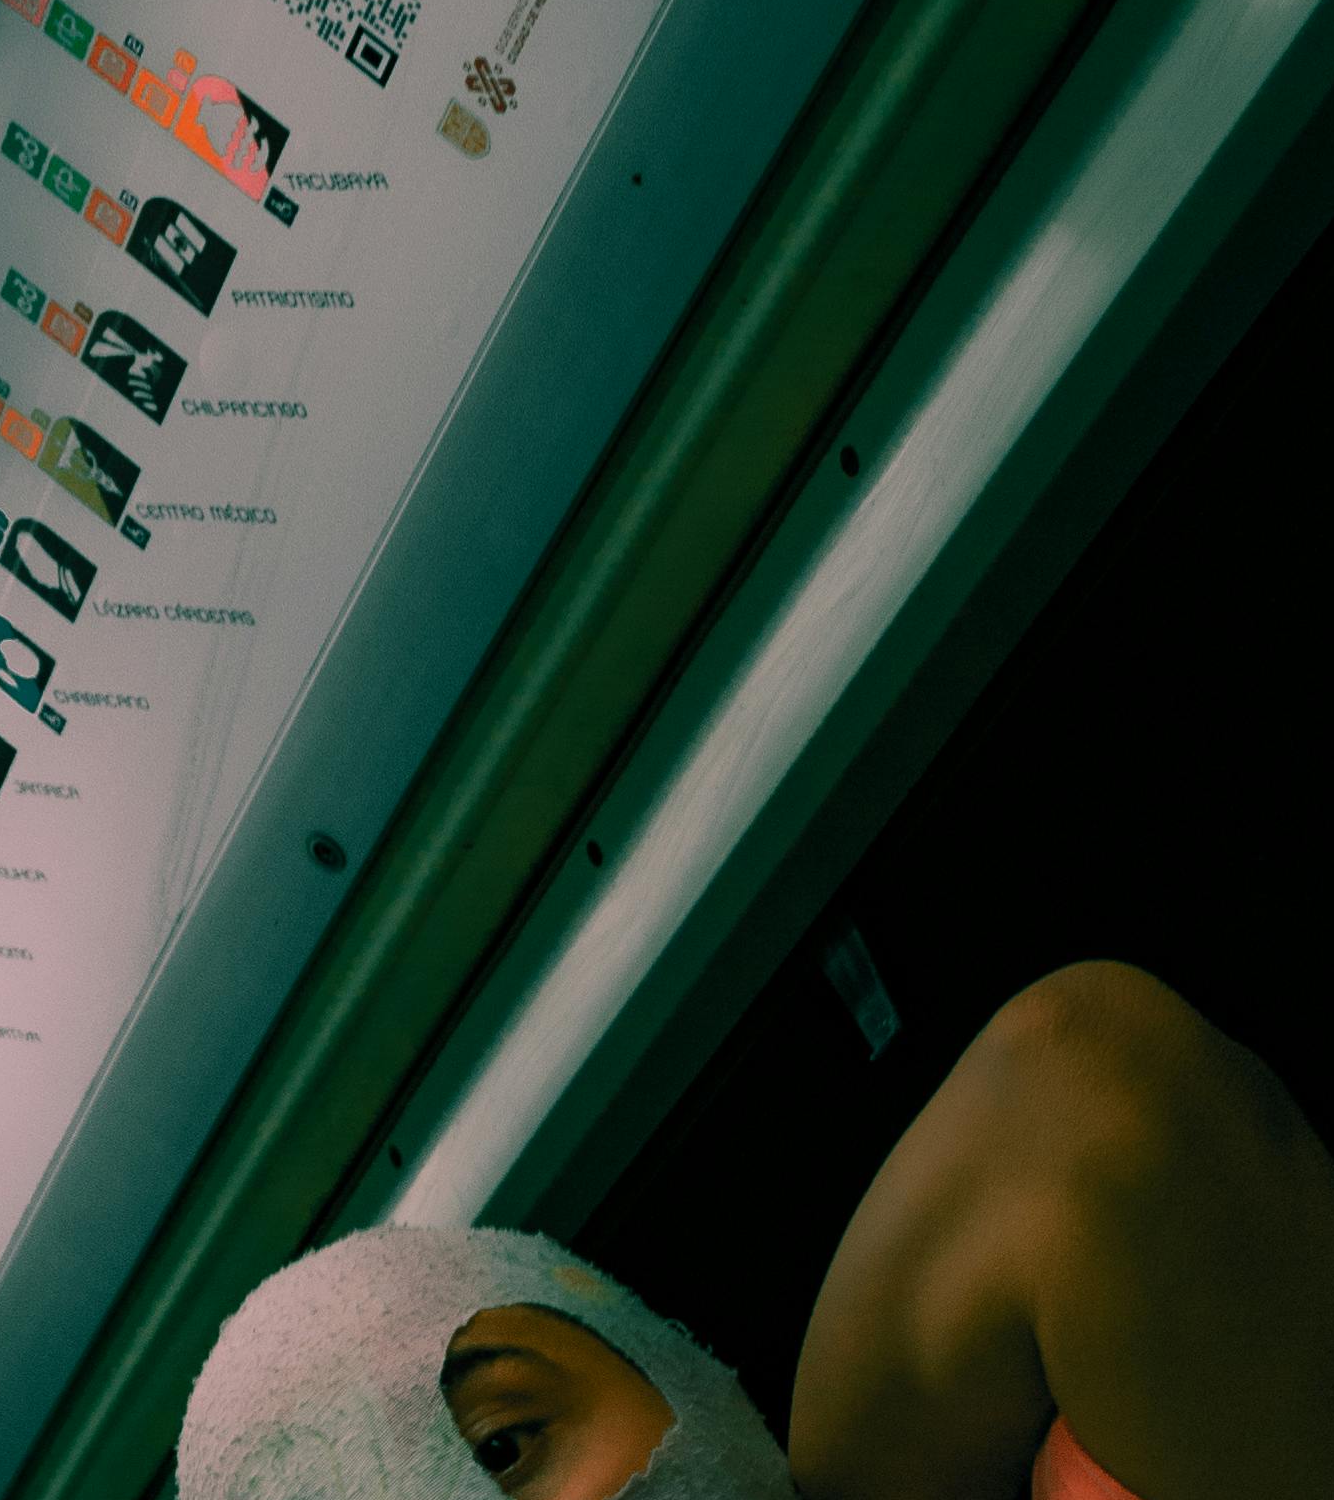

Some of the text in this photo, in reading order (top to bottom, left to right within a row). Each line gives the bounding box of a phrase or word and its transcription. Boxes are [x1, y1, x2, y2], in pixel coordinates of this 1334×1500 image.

[283, 172, 388, 191] TACUBAYA
[231, 290, 354, 309] PATRIOTISMO
[181, 400, 308, 419] CHILPANCINGO
[136, 503, 276, 524] CENTRO MÉDICO
[92, 599, 255, 627] LÁZARO CÁRDENAS
[53, 690, 150, 710] CHABACANO
